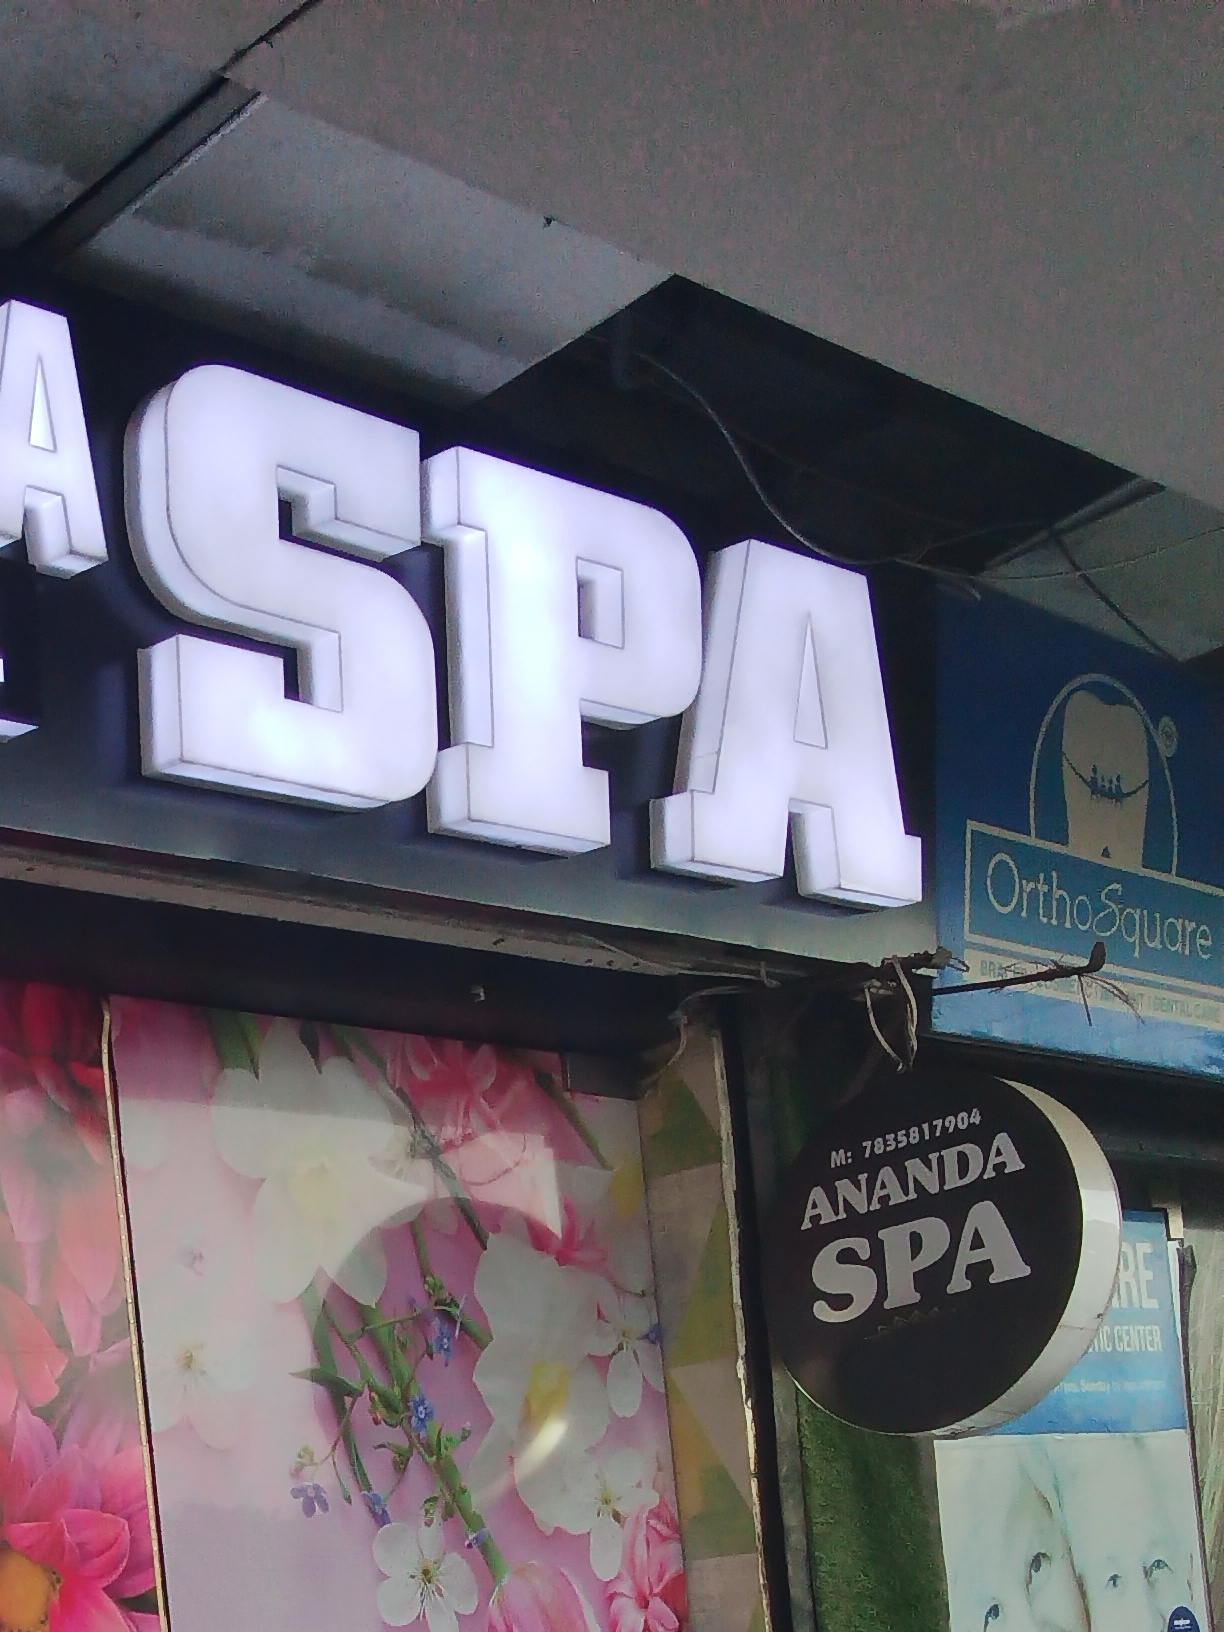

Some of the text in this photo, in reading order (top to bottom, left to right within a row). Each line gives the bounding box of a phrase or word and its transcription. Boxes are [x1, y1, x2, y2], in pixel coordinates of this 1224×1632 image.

[124, 364, 922, 907] SPA
[830, 1108, 982, 1168] M: 7835817904
[800, 1132, 1025, 1230] ANANDA
[811, 1200, 1031, 1323] SPA
[1111, 1241, 1159, 1309] RE
[1114, 1324, 1163, 1352] CENTER
